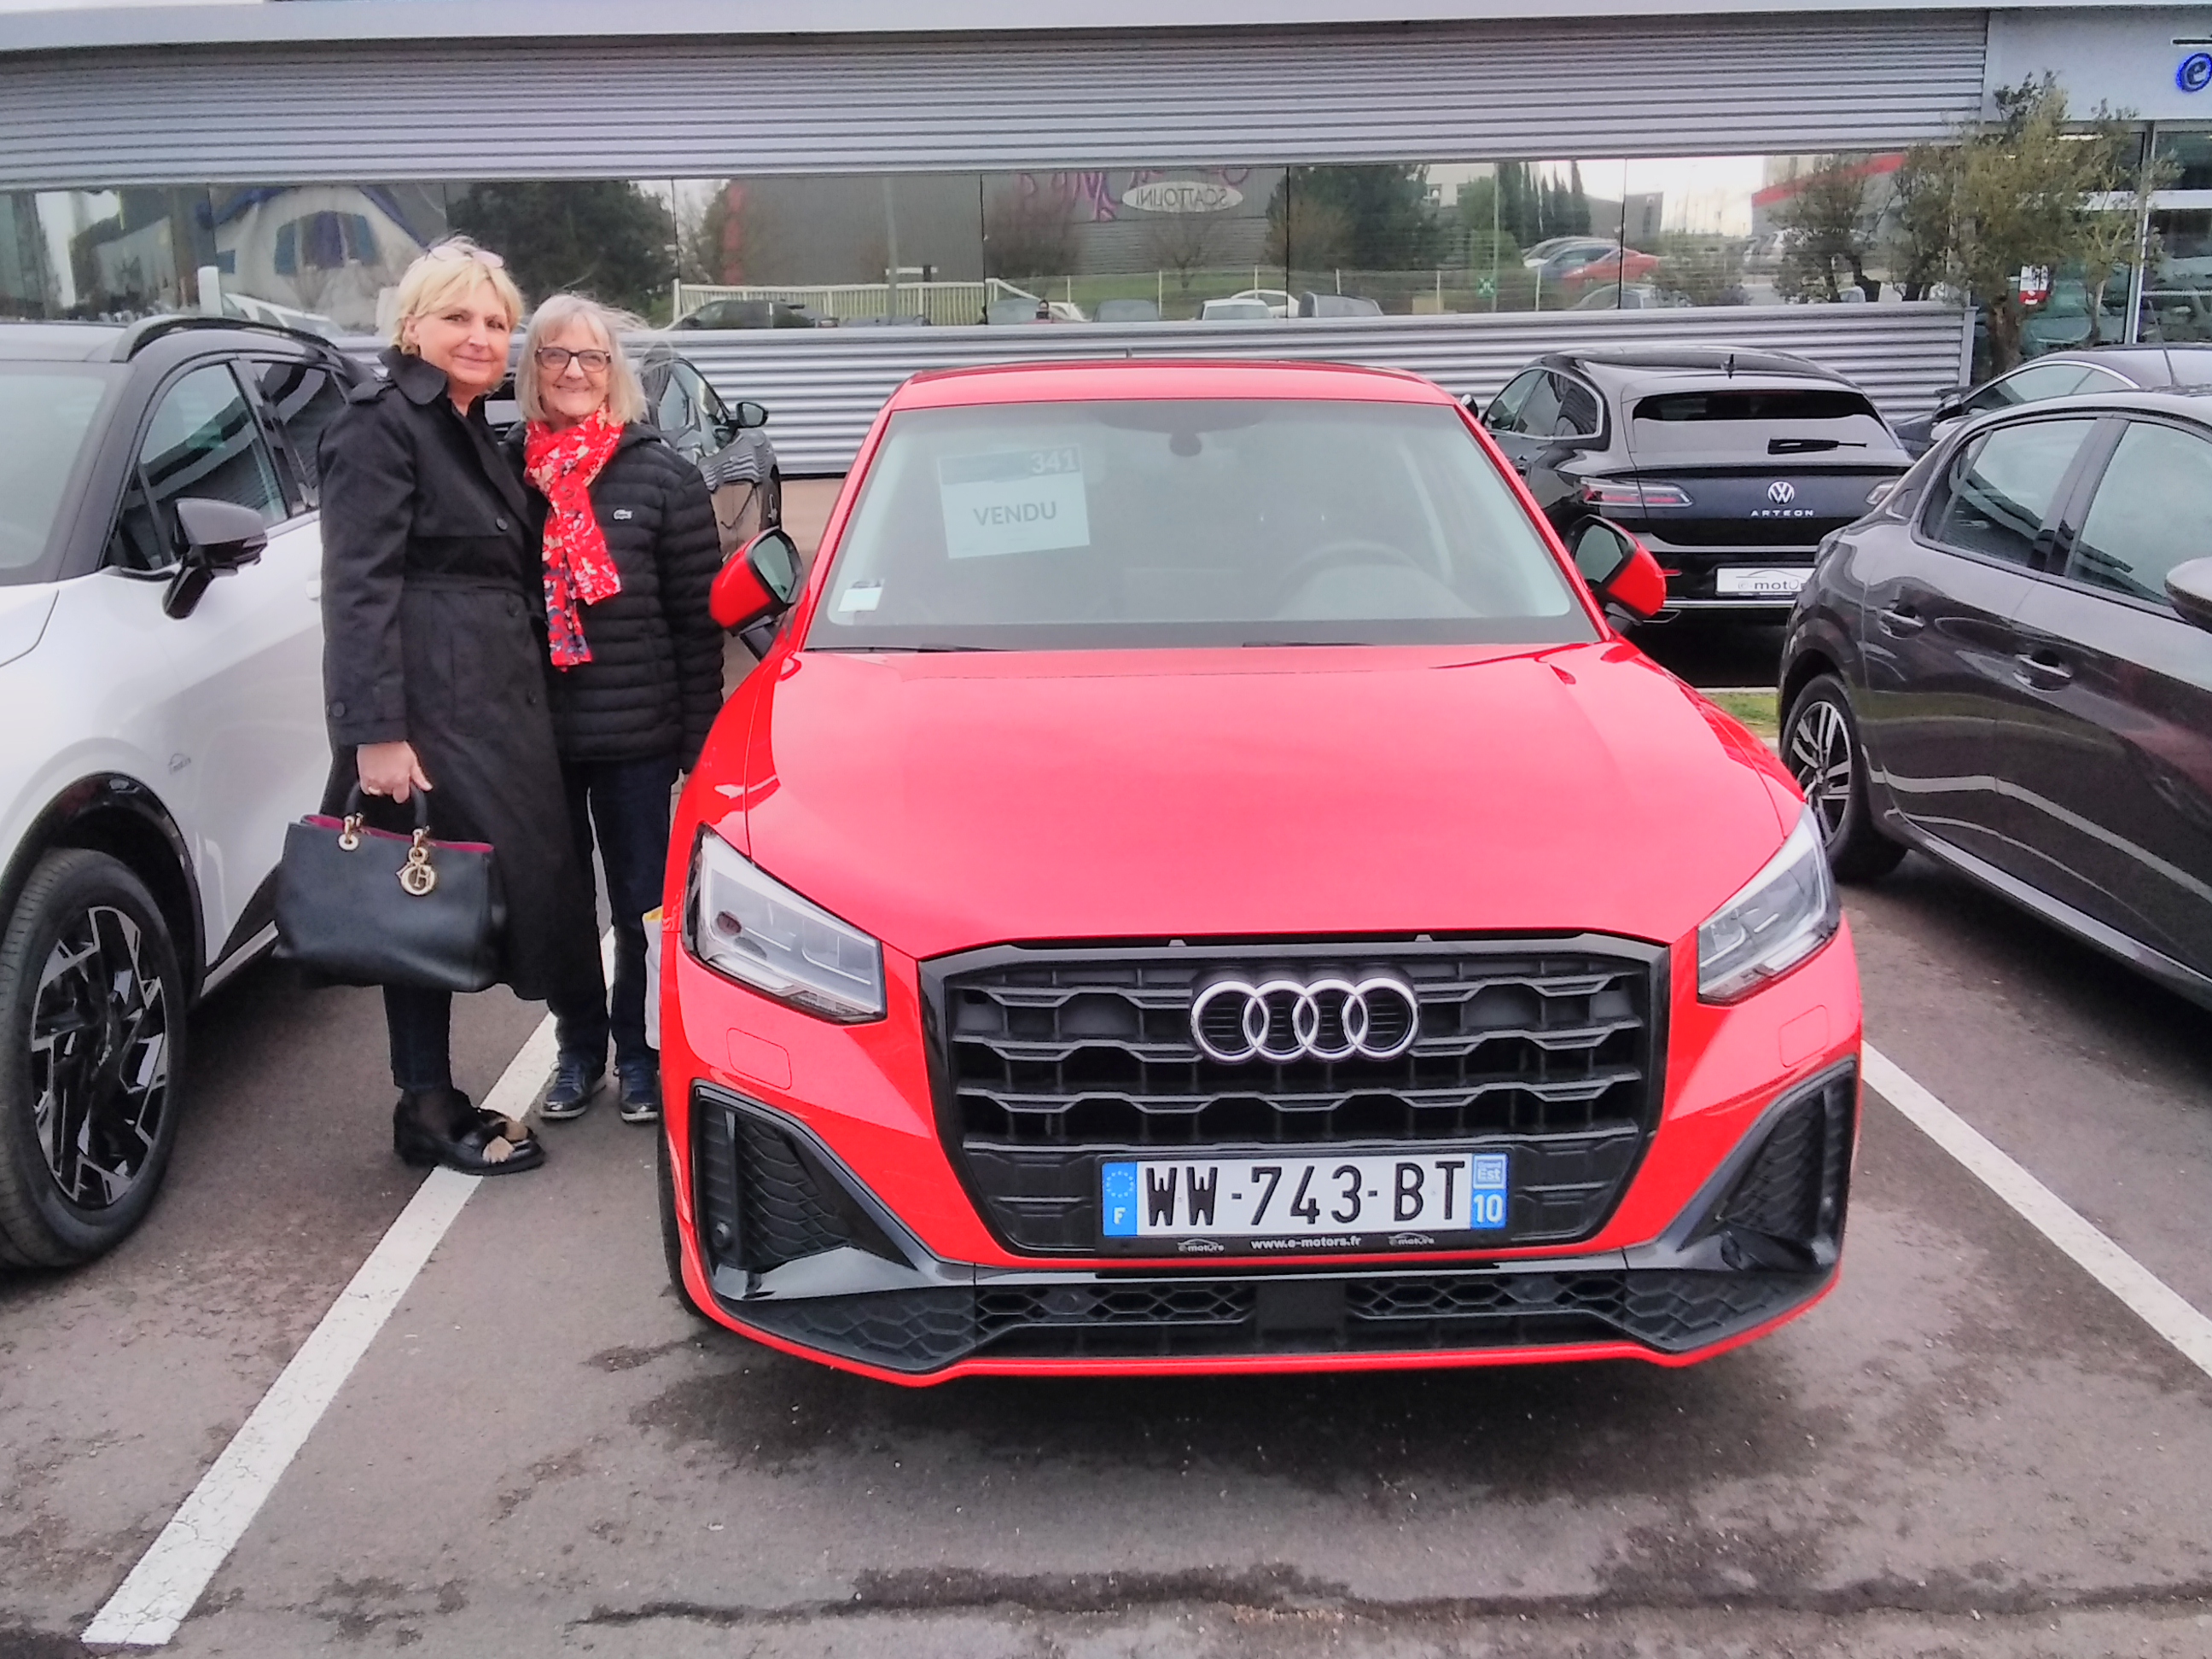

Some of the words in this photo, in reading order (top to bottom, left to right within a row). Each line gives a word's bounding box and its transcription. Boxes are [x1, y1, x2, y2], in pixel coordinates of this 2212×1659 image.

[1030, 449, 1076, 474] 341
[973, 501, 1057, 526] VENDU
[1477, 1168, 1501, 1181] Est
[1113, 1207, 1126, 1225] F
[1473, 1194, 1503, 1224] 10
[1250, 1235, 1362, 1250] www.e-motors.fr
